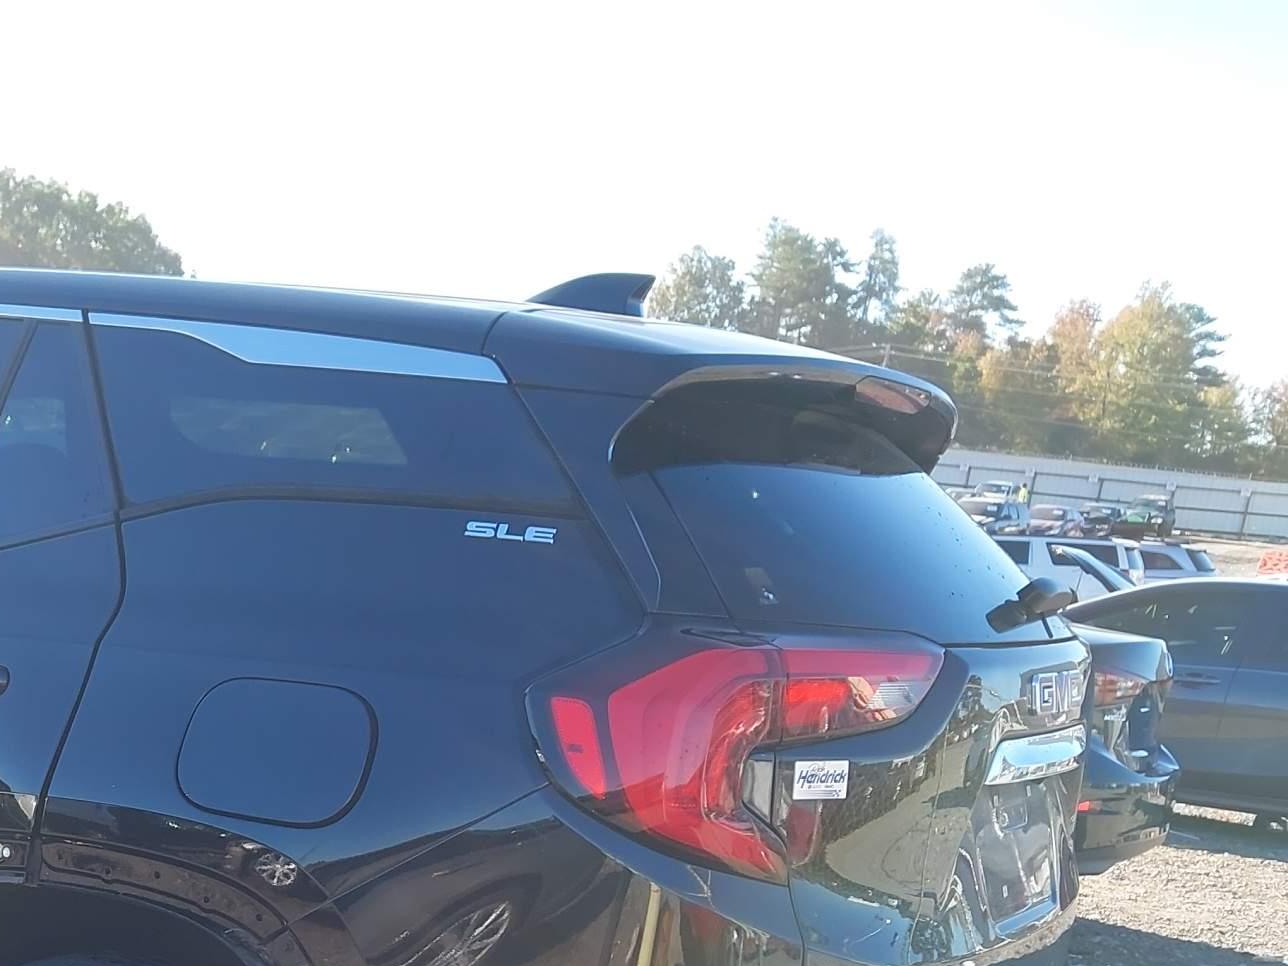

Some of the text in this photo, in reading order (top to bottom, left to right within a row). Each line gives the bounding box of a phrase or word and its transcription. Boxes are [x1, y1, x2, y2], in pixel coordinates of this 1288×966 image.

[464, 521, 557, 544] SLE
[1032, 670, 1084, 713] GMC
[796, 769, 847, 789] Hendrick
